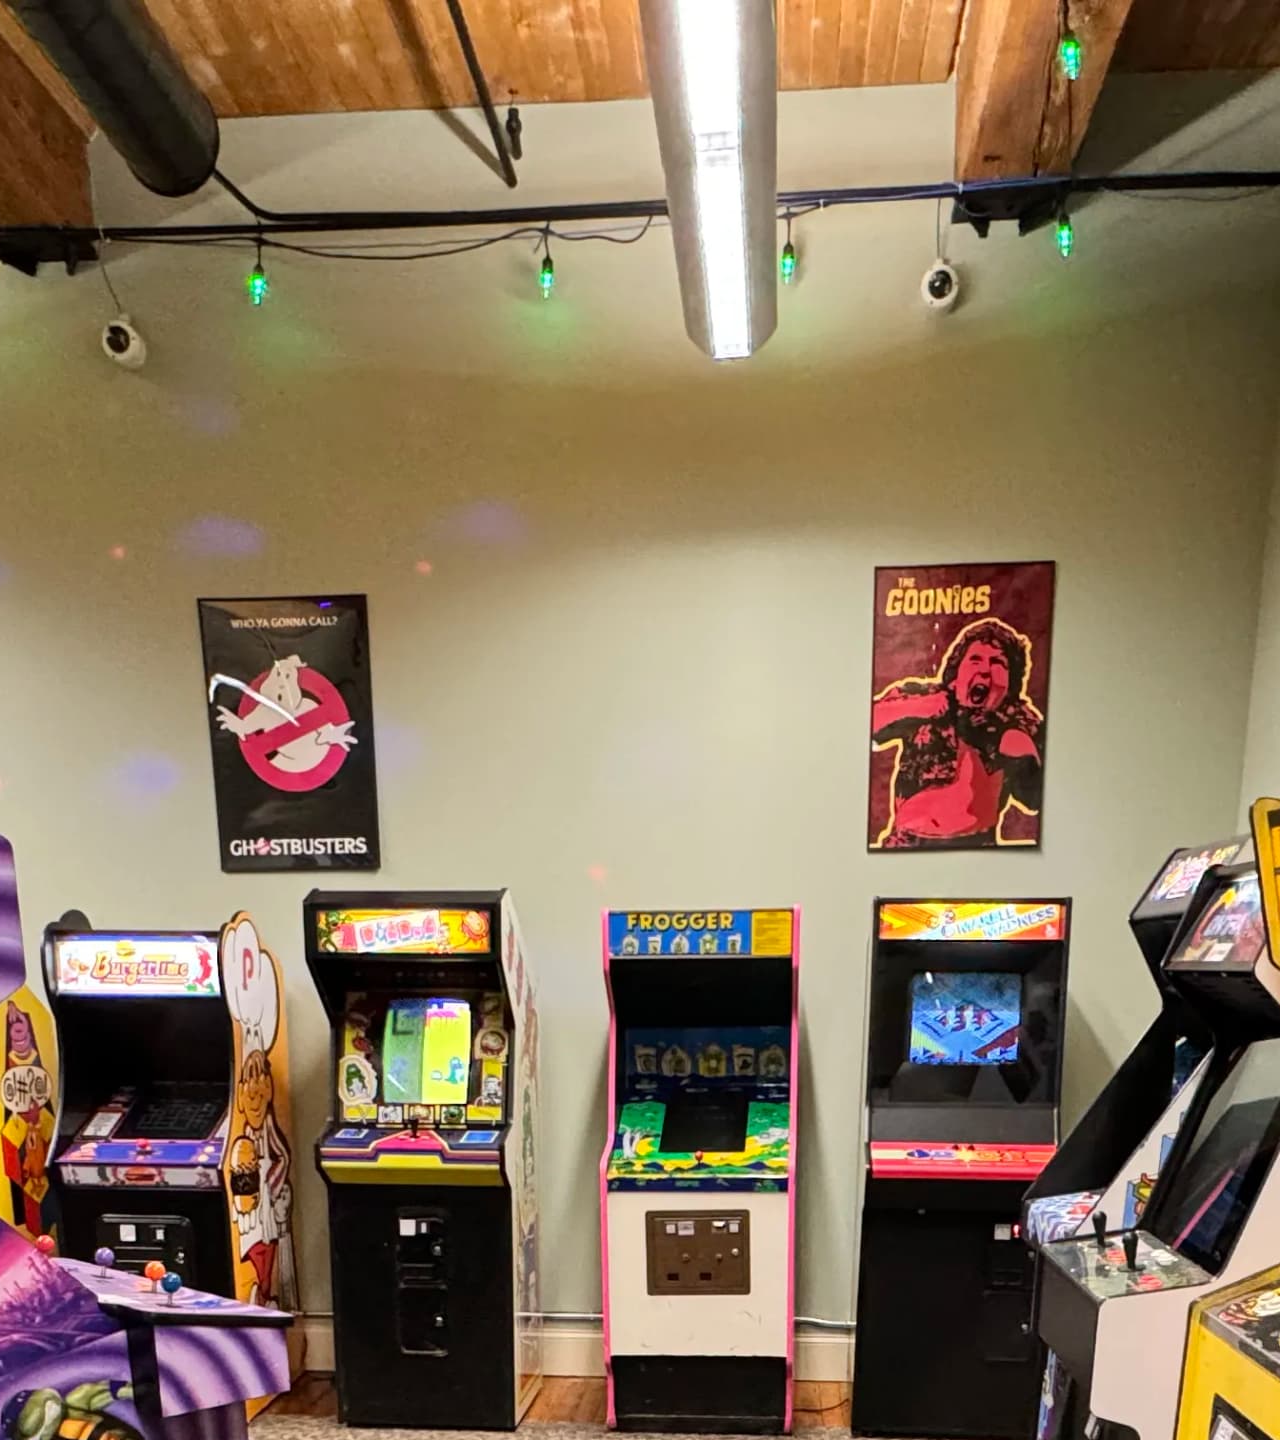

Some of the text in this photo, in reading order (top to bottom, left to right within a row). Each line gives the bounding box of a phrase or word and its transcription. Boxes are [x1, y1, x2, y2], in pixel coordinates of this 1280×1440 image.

[231, 616, 338, 628] WHO YA GONNA CALL?
[627, 912, 734, 931] FROGGER
